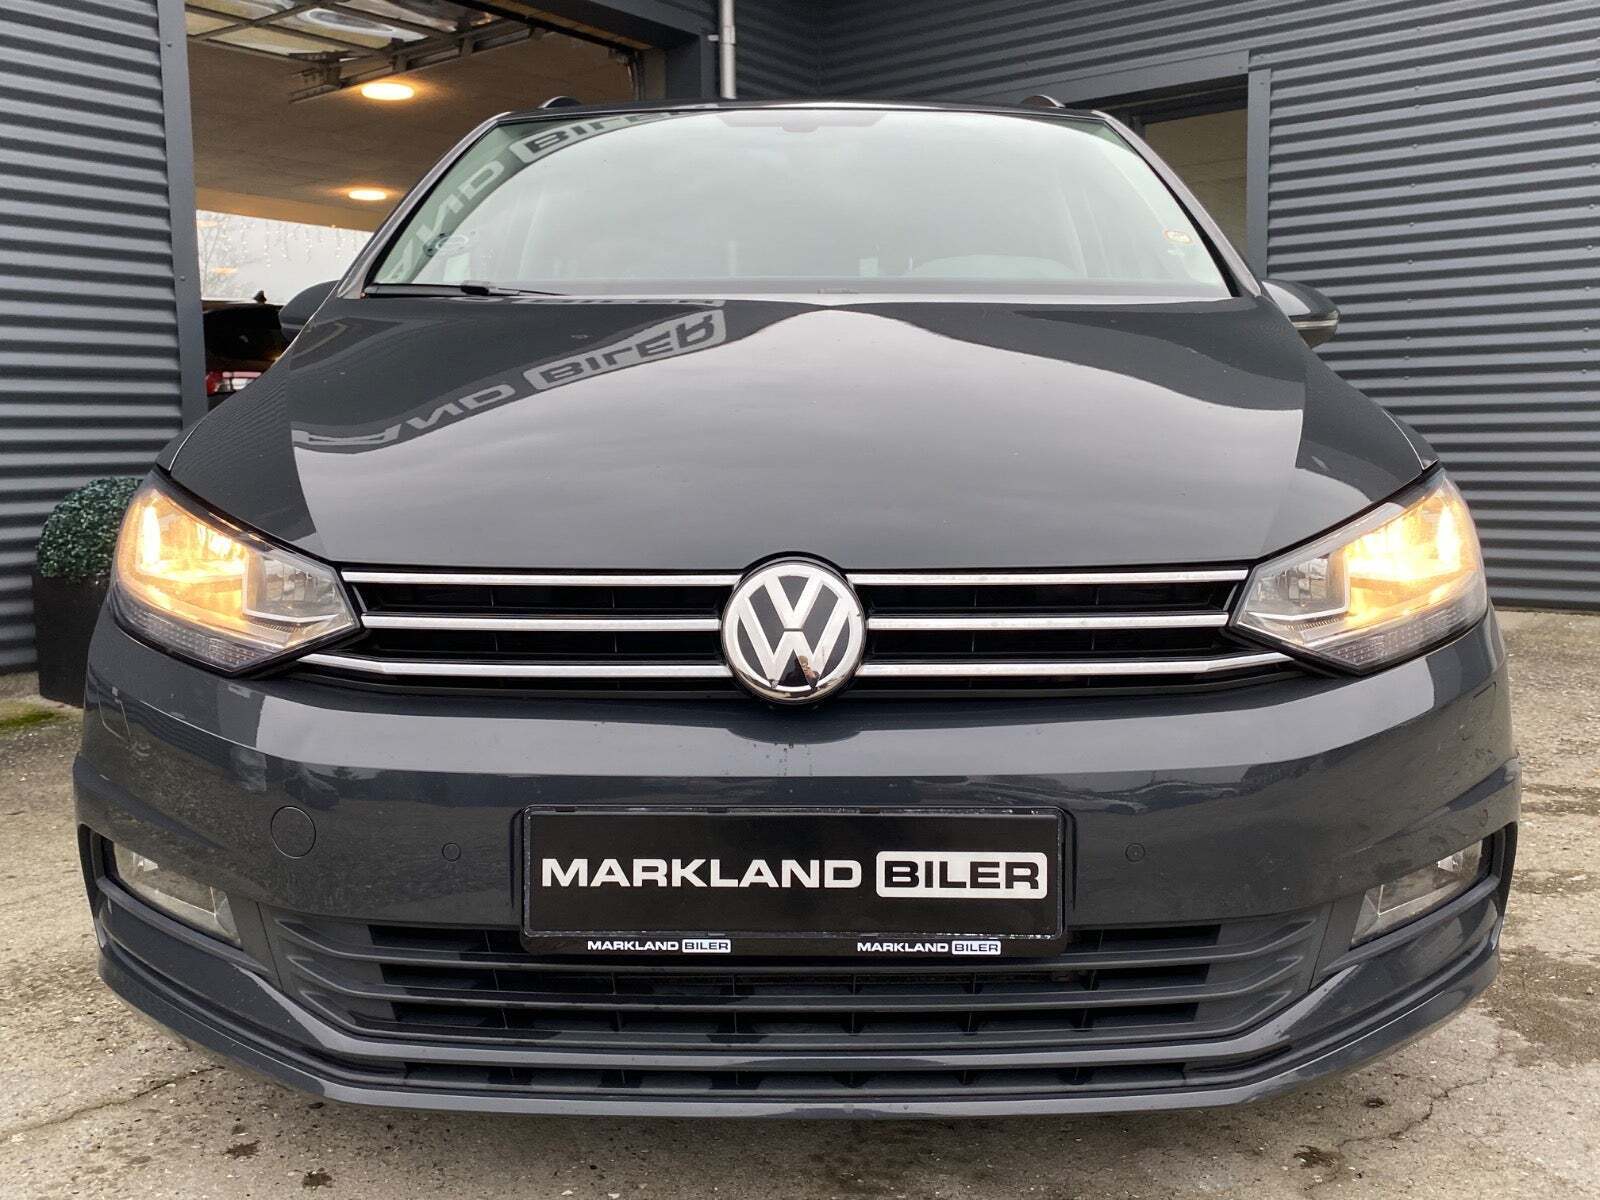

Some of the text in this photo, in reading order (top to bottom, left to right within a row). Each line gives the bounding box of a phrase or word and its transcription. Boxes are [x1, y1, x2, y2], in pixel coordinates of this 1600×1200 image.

[541, 858, 1040, 890] MARKLAND BILER
[586, 940, 730, 952] MARKLAND BILER
[856, 941, 999, 953] MARKLAND BILER
